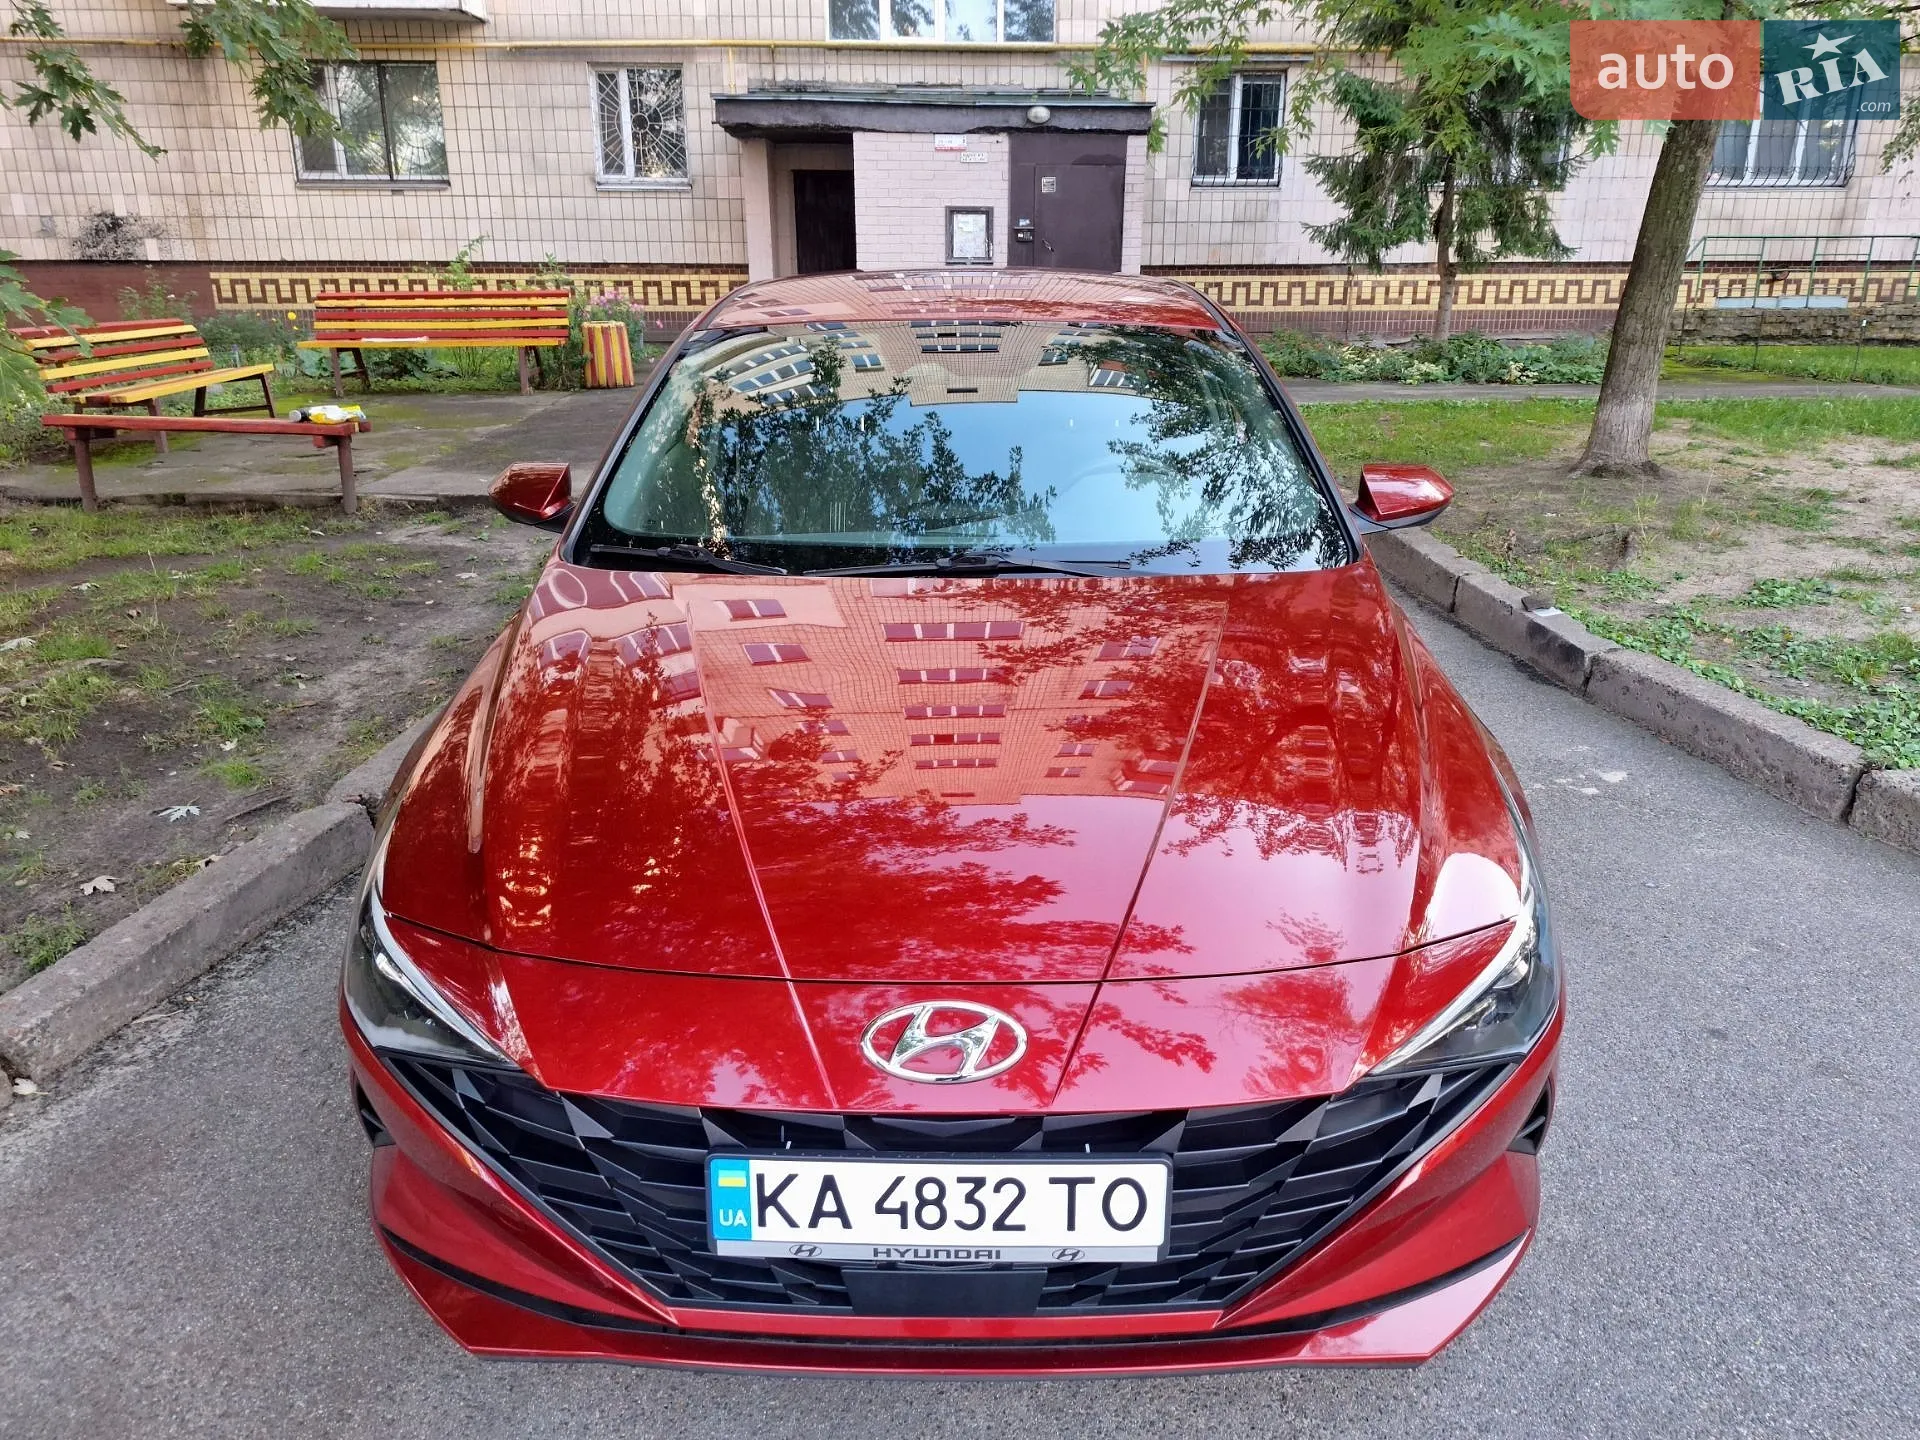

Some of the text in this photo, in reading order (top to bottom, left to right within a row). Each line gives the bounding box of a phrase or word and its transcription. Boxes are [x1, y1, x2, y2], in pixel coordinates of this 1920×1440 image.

[756, 1173, 1147, 1231] KA 4832 TO
[719, 1208, 748, 1227] UA
[873, 1247, 1001, 1260] HYUNDAI
